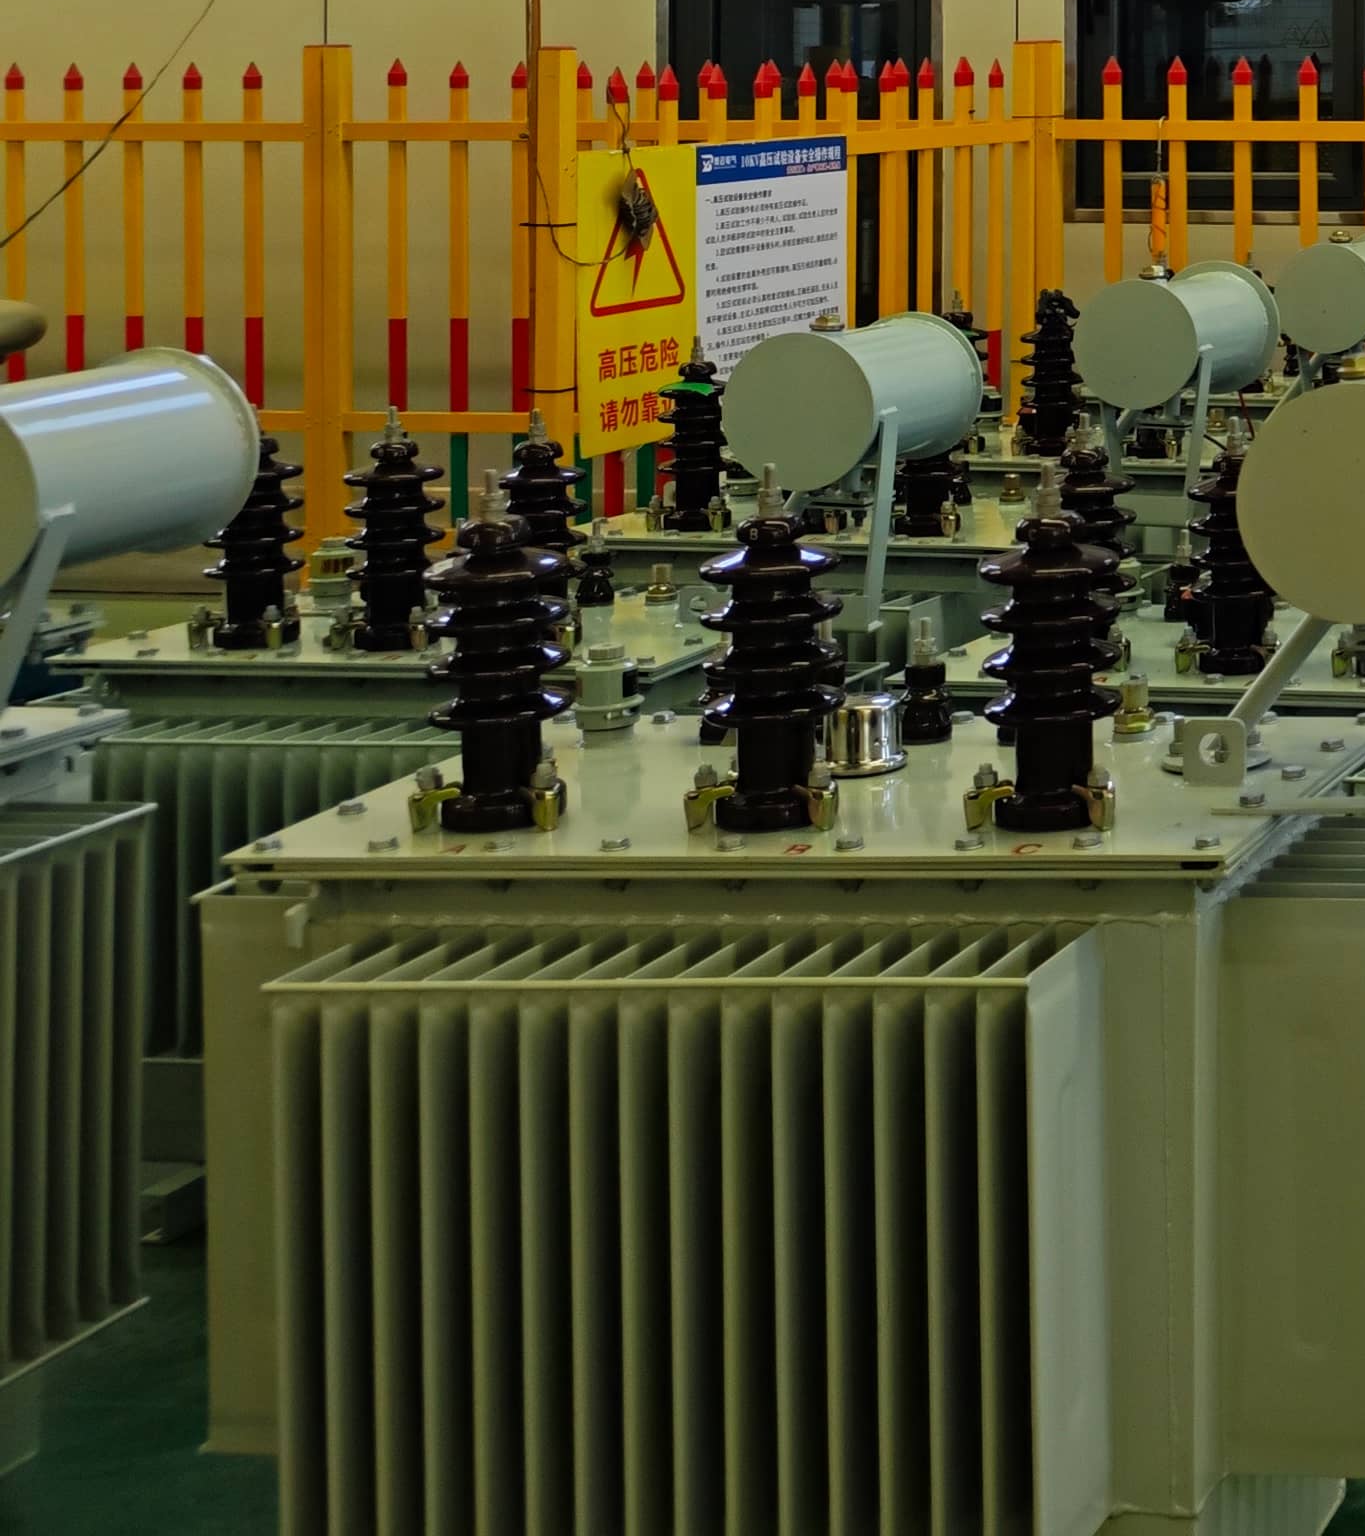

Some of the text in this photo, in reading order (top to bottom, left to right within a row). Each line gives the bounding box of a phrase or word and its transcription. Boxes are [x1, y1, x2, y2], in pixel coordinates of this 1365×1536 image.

[598, 336, 679, 382] 高压危险
[600, 392, 674, 433] 请勿靠
